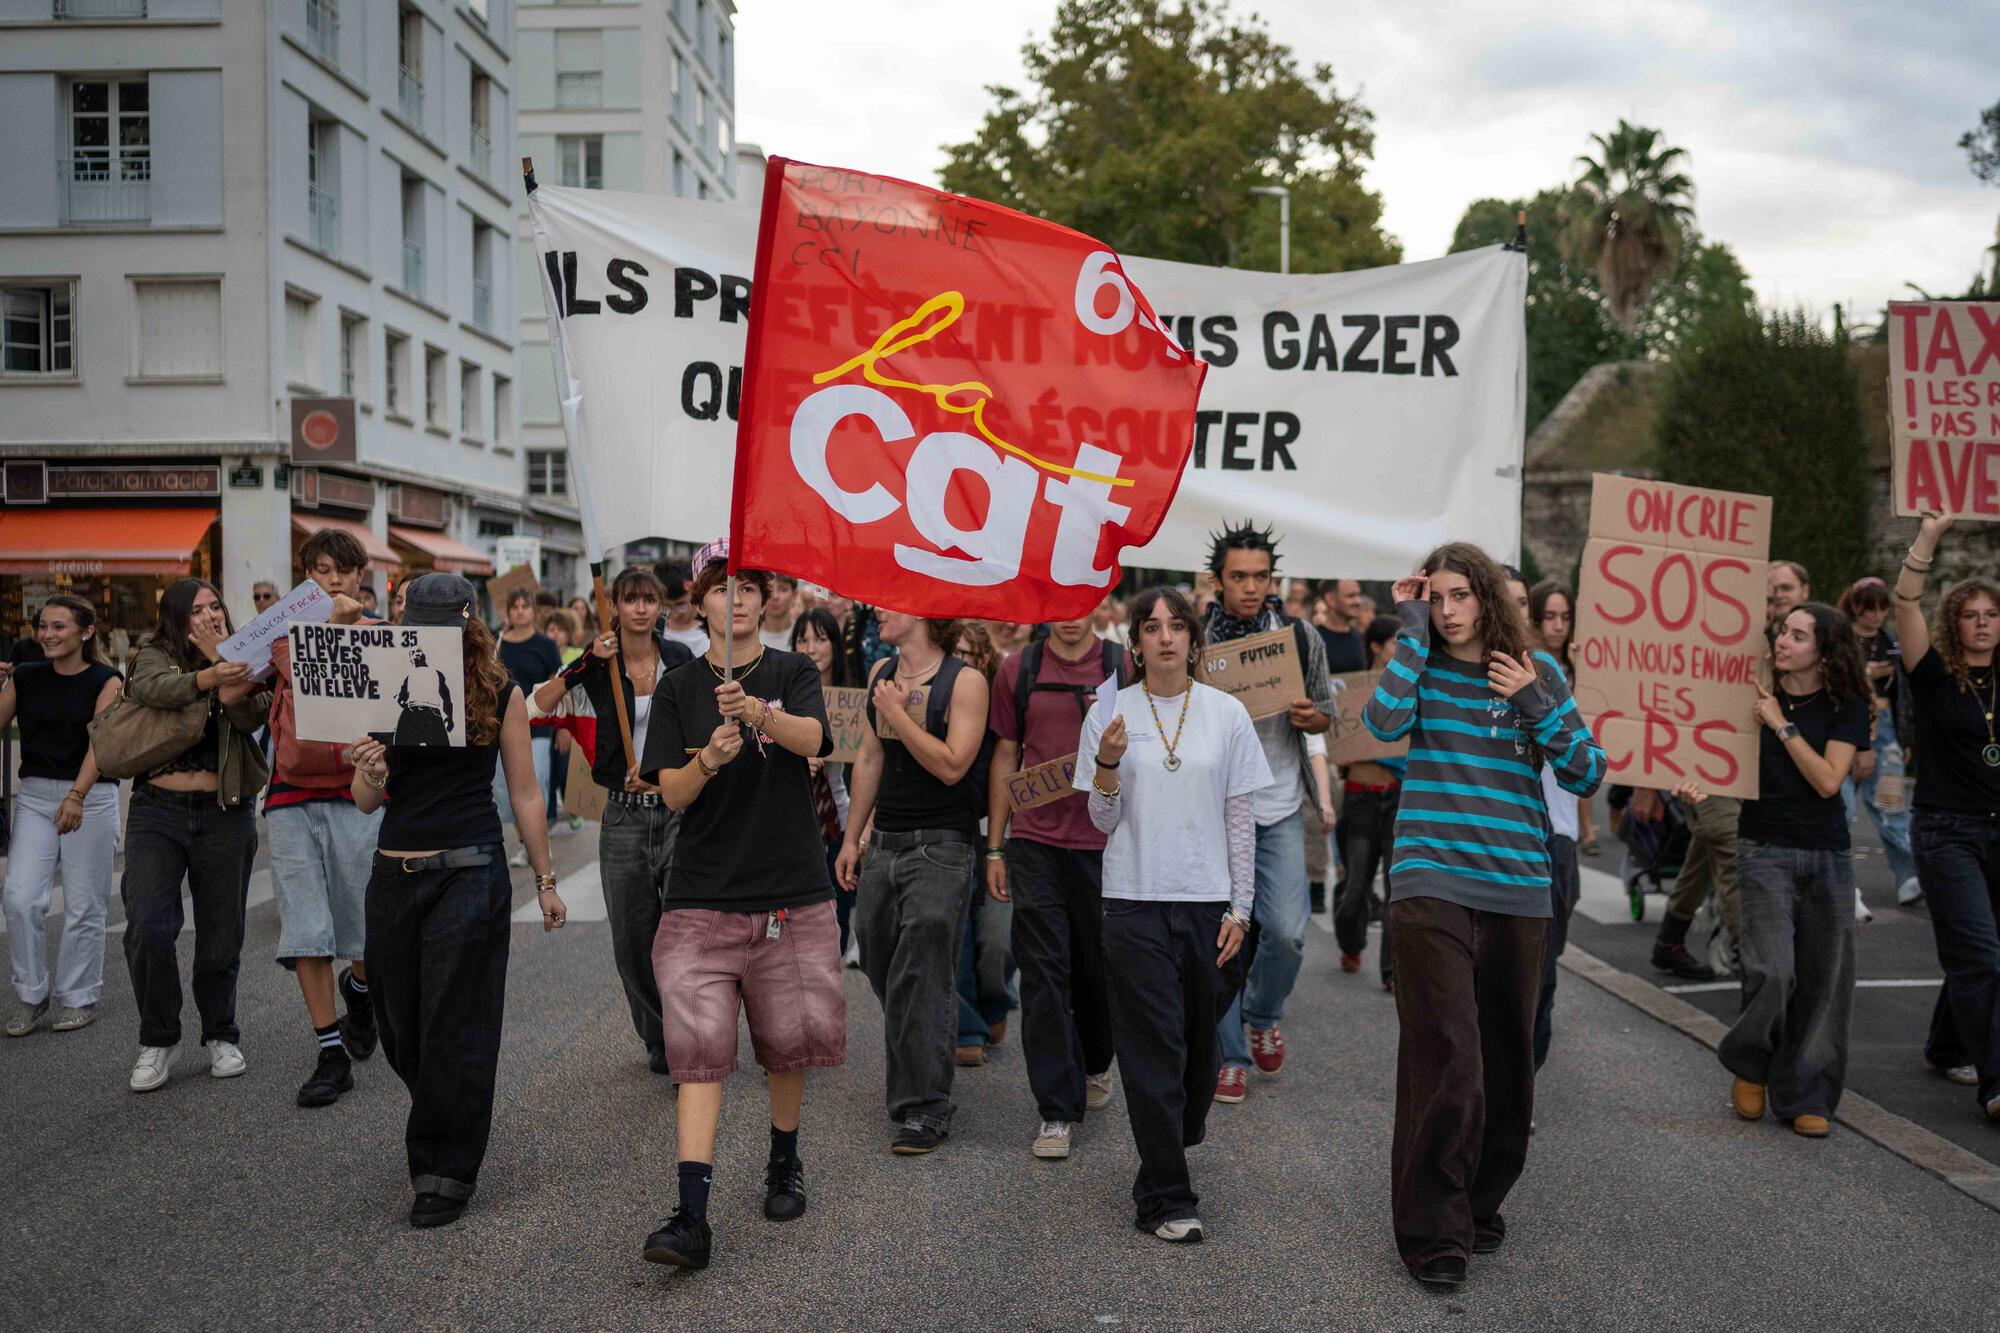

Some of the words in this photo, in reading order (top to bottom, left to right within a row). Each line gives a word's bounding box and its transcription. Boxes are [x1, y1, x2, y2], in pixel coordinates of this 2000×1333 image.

[799, 169, 890, 194] PORT
[797, 202, 987, 254] BAYONNE
[792, 241, 861, 275] CCI
[545, 250, 649, 320] ILS
[1262, 310, 1460, 377] GAZER
[1891, 305, 2000, 376] TAX
[1927, 380, 1980, 407] LES
[1931, 411, 1977, 437] PAS
[54, 470, 209, 491] Parapharmacie
[790, 384, 1131, 587] cgt
[1627, 487, 1673, 534] ON
[1677, 495, 1757, 546] CRIE
[1595, 545, 1751, 646] SOS
[233, 641, 247, 652] LA
[350, 629, 394, 648] POUR
[401, 630, 418, 648] 35
[296, 645, 363, 665] ELEVES
[1207, 657, 1228, 672] NO
[1240, 642, 1286, 665] FUTURE
[1584, 635, 1620, 673] ON
[1627, 637, 1685, 676] NOUS
[1692, 645, 1758, 686] ENVOIE
[302, 663, 328, 679] CRS
[331, 663, 371, 681] POUR
[300, 677, 322, 696] UN
[325, 679, 380, 700] ELEVE
[1638, 680, 1696, 722] LES
[1592, 707, 1740, 788] CRS
